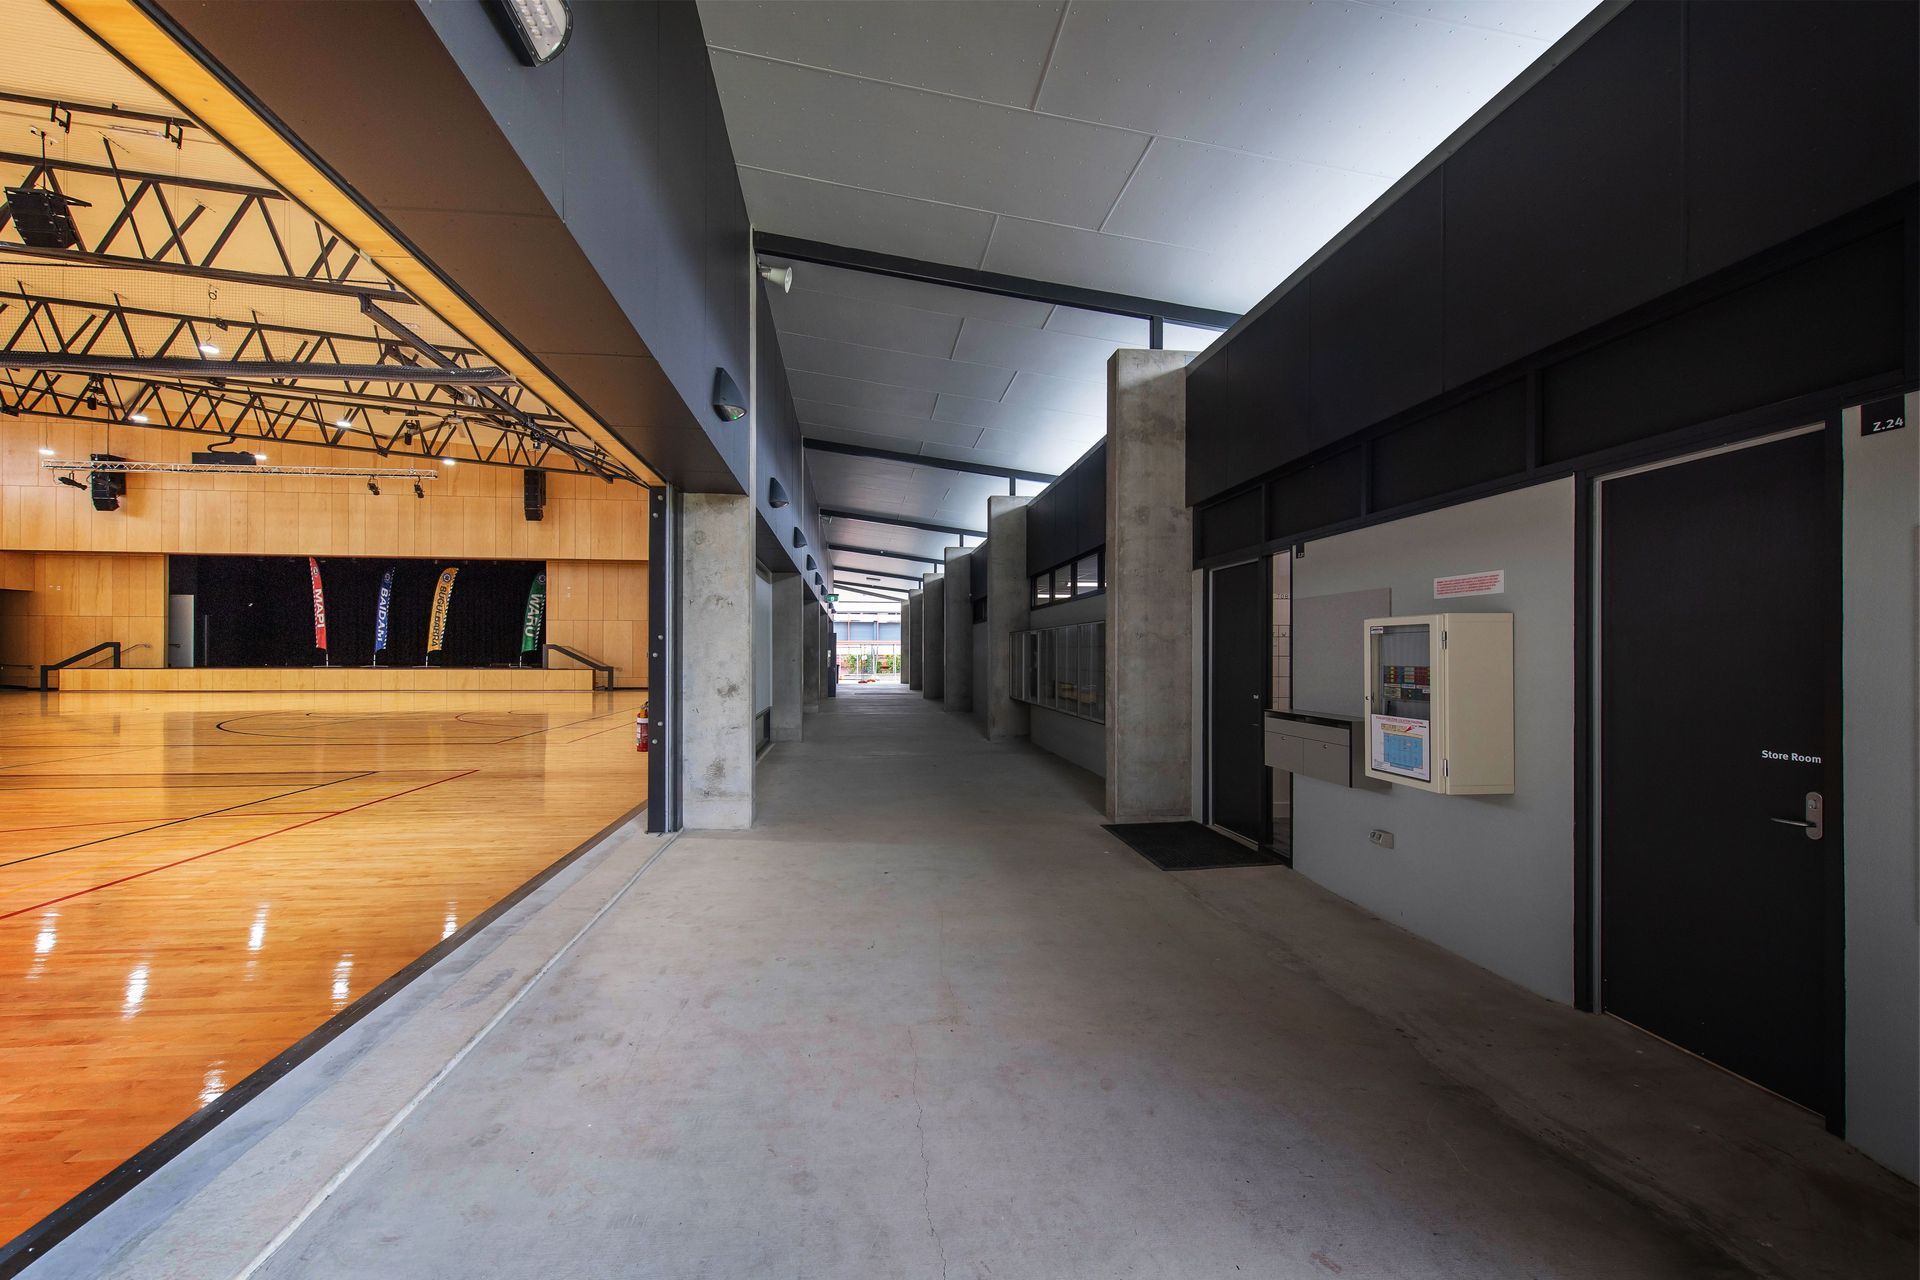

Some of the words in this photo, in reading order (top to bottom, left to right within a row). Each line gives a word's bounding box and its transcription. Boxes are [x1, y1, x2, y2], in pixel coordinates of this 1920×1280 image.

[1873, 417, 1904, 432] Z.24
[314, 588, 325, 628] MAPI
[377, 587, 389, 642] BAIDAM
[525, 593, 543, 637] WARU
[1761, 749, 1789, 761] Store
[1791, 752, 1822, 764] Room
